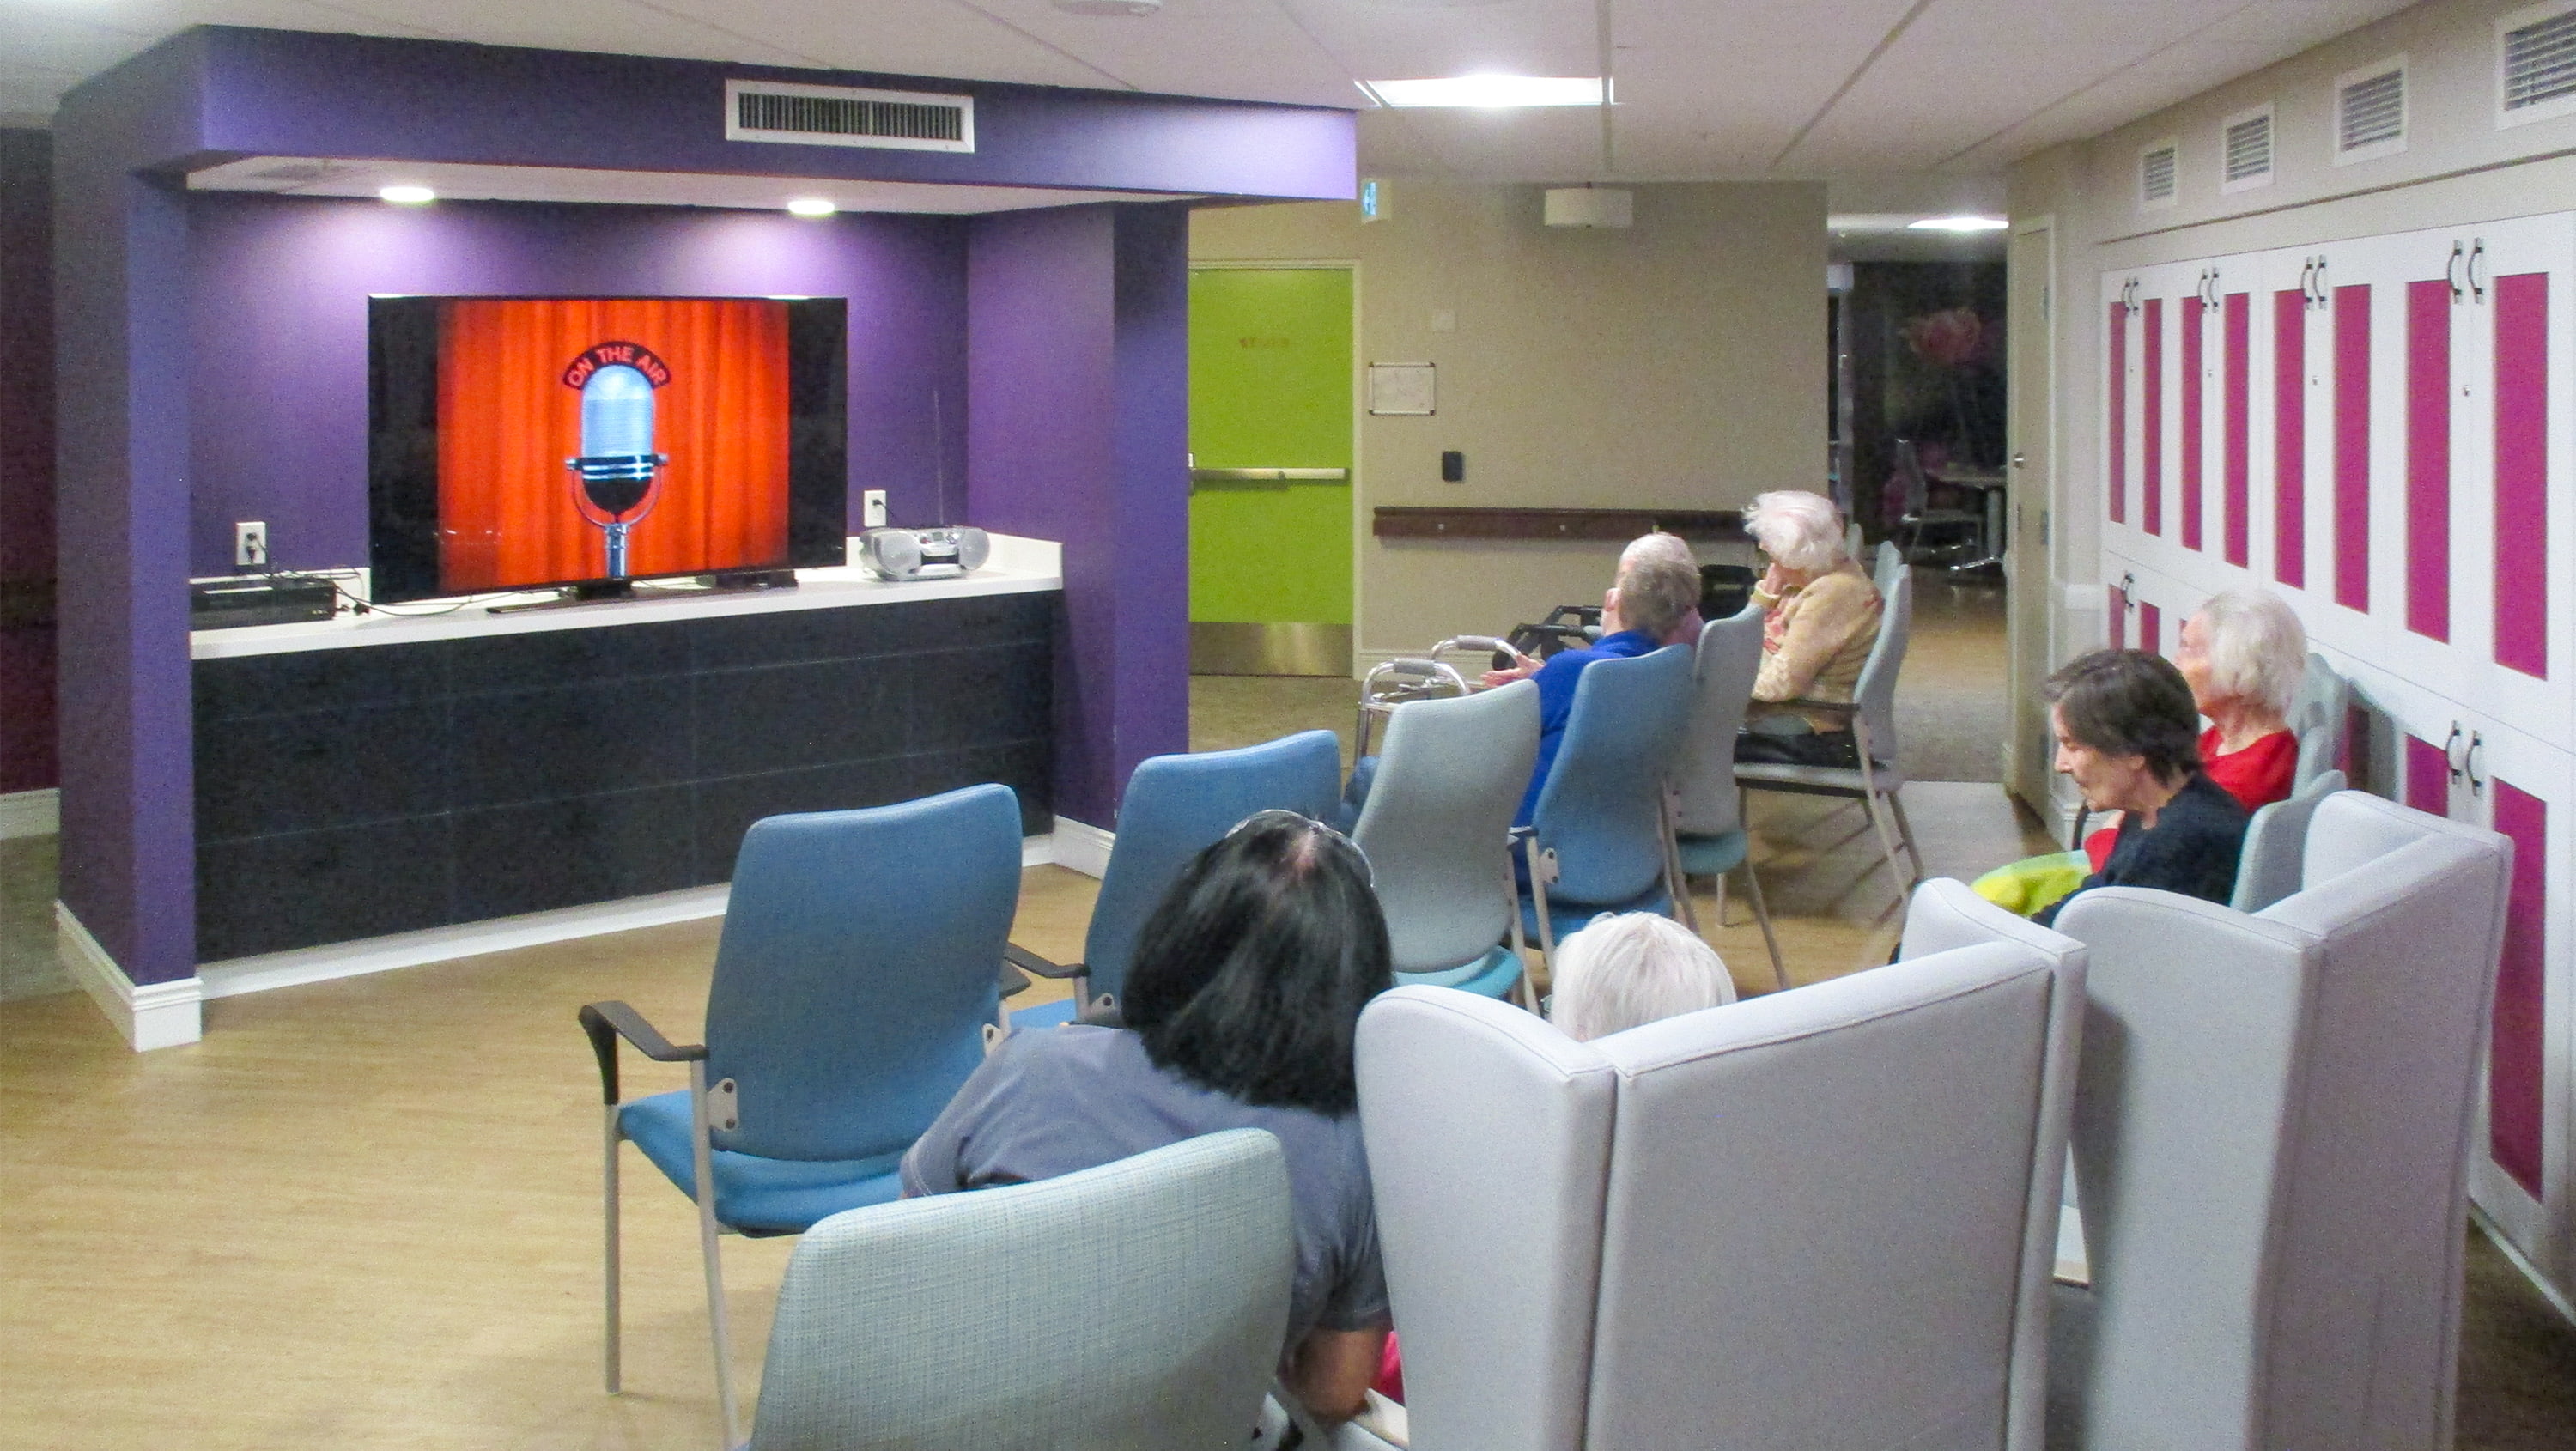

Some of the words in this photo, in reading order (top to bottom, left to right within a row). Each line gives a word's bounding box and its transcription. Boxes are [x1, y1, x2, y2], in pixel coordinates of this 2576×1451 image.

[567, 357, 594, 386] ON
[595, 346, 634, 363] THE
[635, 355, 667, 386] AIR
